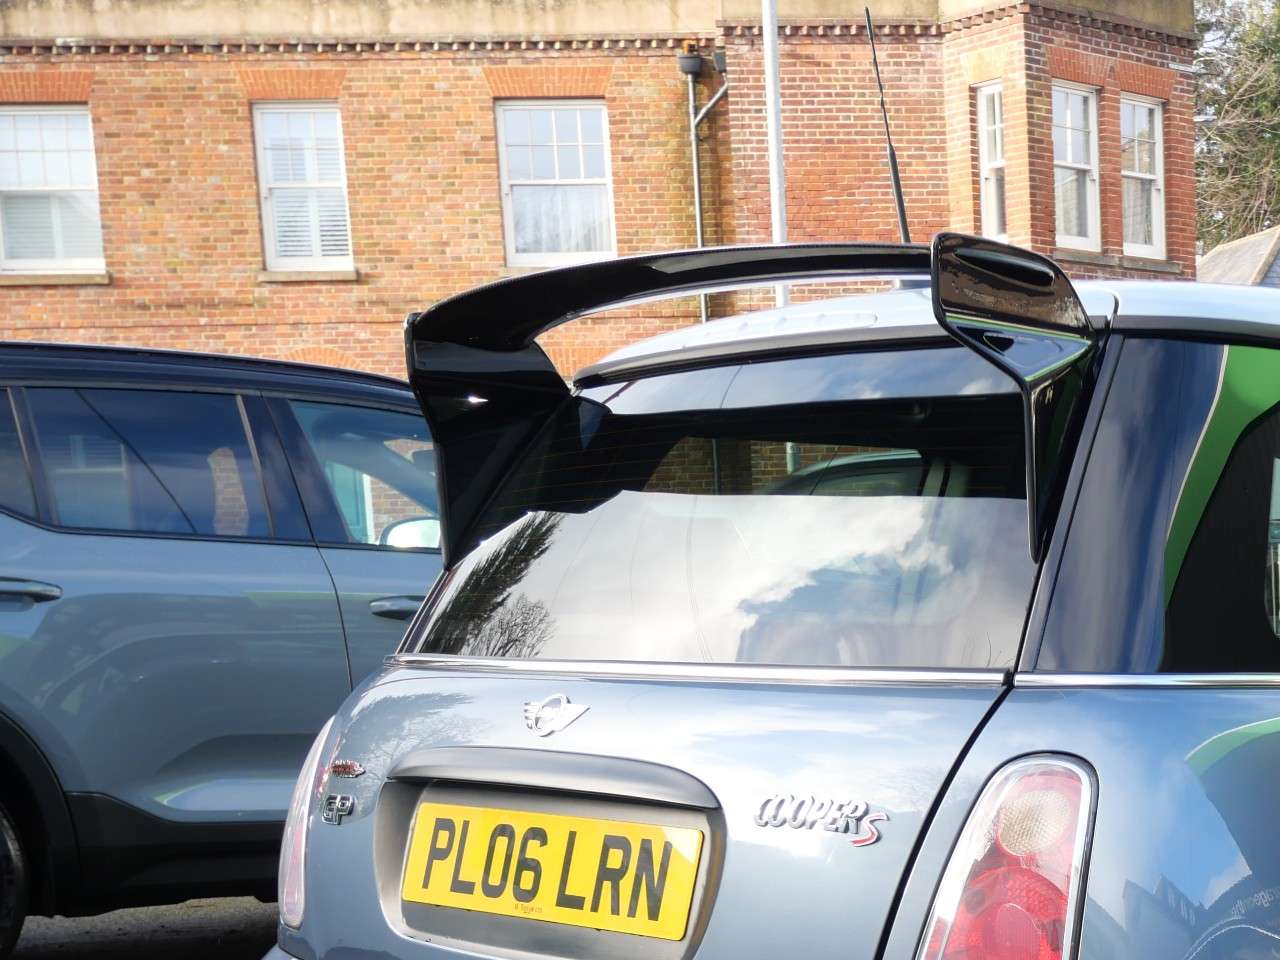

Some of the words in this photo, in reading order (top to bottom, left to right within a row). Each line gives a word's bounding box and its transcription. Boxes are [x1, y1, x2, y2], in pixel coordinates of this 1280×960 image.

[322, 794, 354, 825] GP
[754, 794, 869, 834] COOPER
[849, 811, 890, 847] S
[422, 817, 548, 903] PL06
[555, 830, 673, 922] LRN
